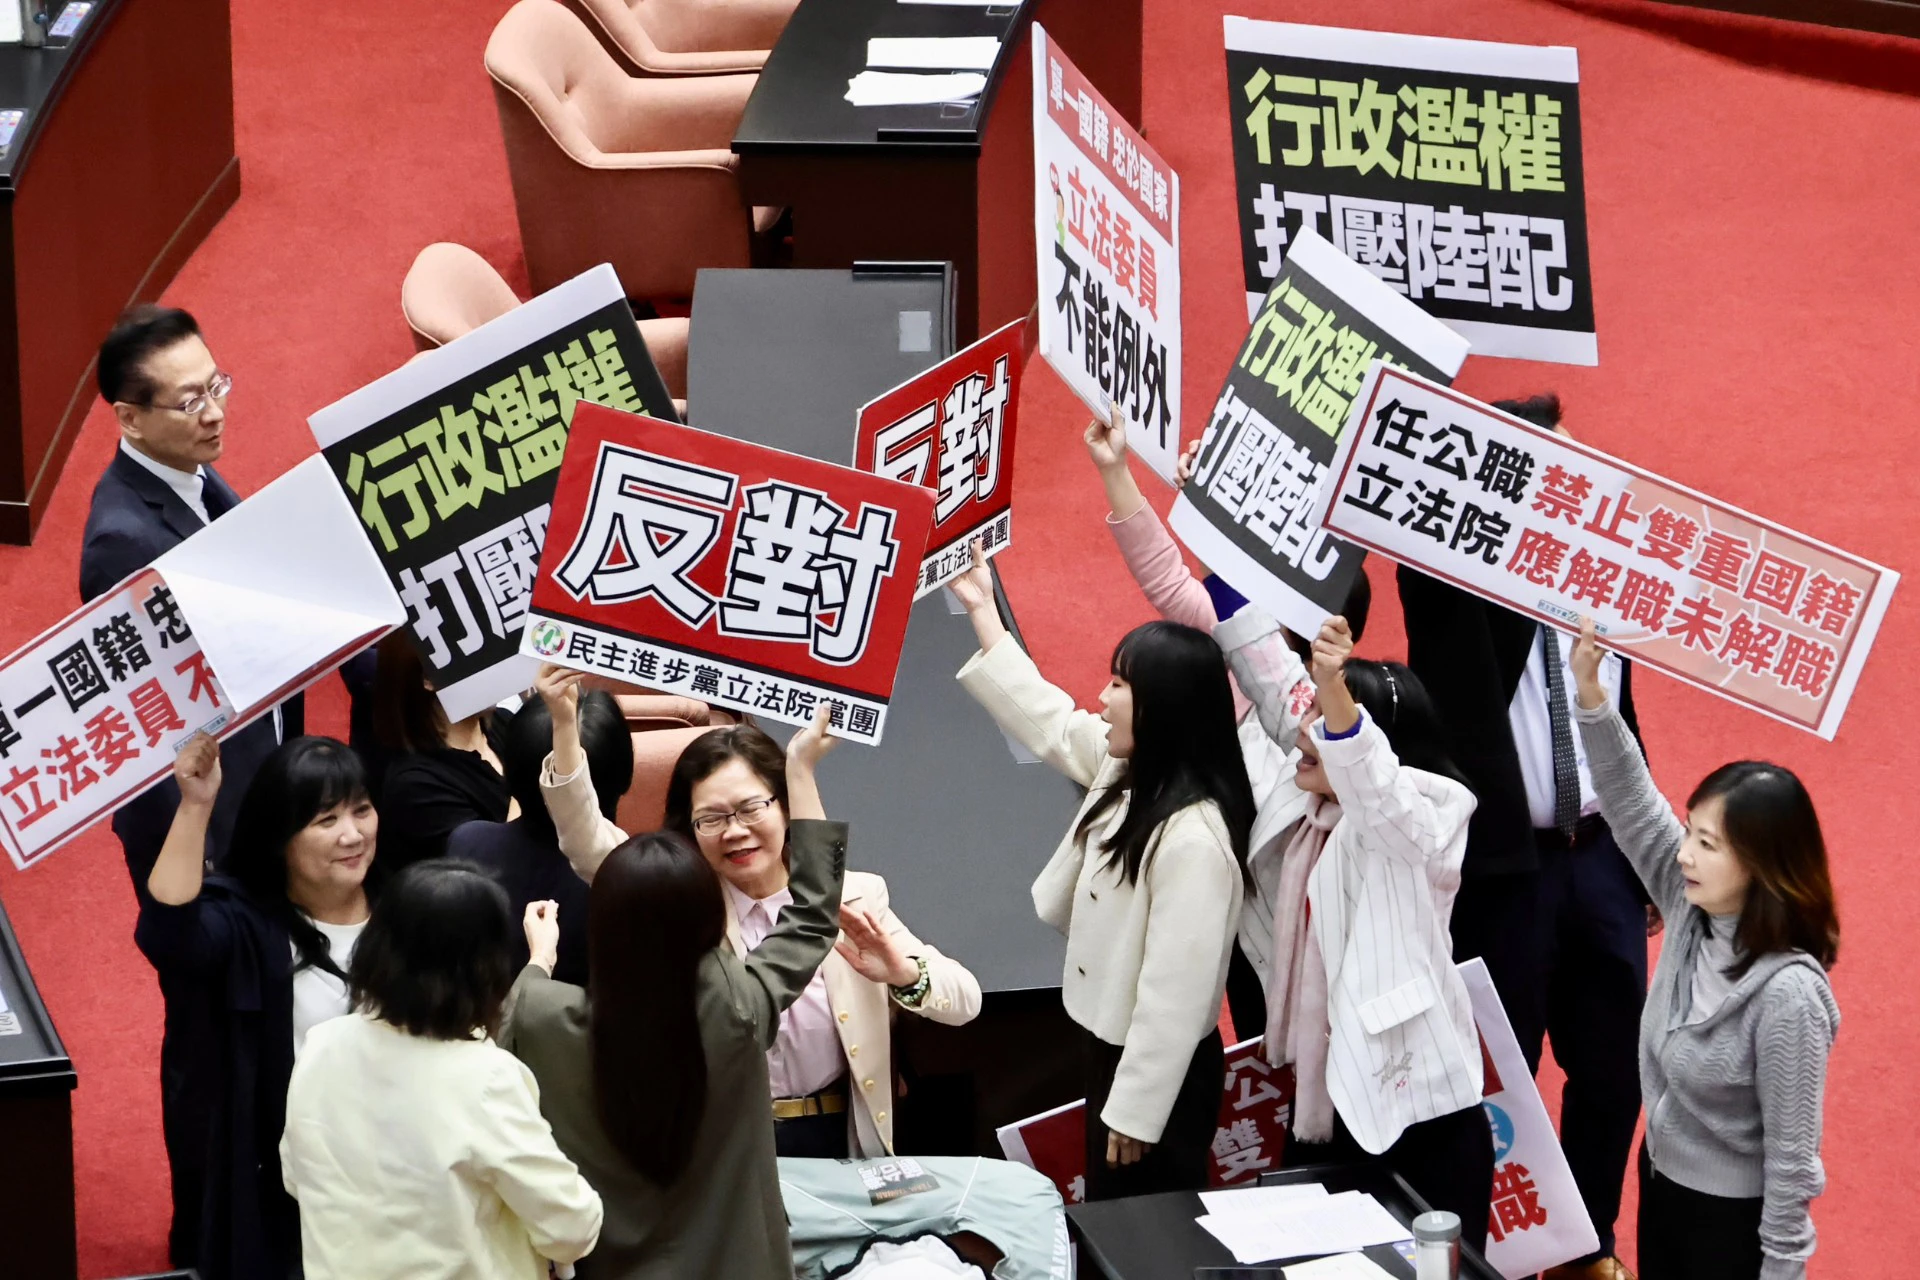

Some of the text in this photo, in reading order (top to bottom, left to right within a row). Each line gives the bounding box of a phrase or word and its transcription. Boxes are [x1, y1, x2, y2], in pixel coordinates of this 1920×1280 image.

[1050, 55, 1169, 221] 單一國籍 忠於國家
[1244, 67, 1565, 192] 行政濫權
[1067, 165, 1159, 322] 立法委員
[1254, 183, 1573, 312] 打壓陸配
[1054, 240, 1172, 450] 不能例外
[1239, 277, 1419, 447] 行政濫
[874, 353, 1010, 528] 反對
[1372, 399, 1862, 636] 任公職禁止雙重國籍
[399, 502, 552, 670] 打壓
[551, 440, 900, 667] 反對
[1344, 462, 1840, 699] 立法院應解職未解職
[2, 676, 187, 832] 立法委員
[566, 631, 880, 738] 民主進步黨立法院黨團
